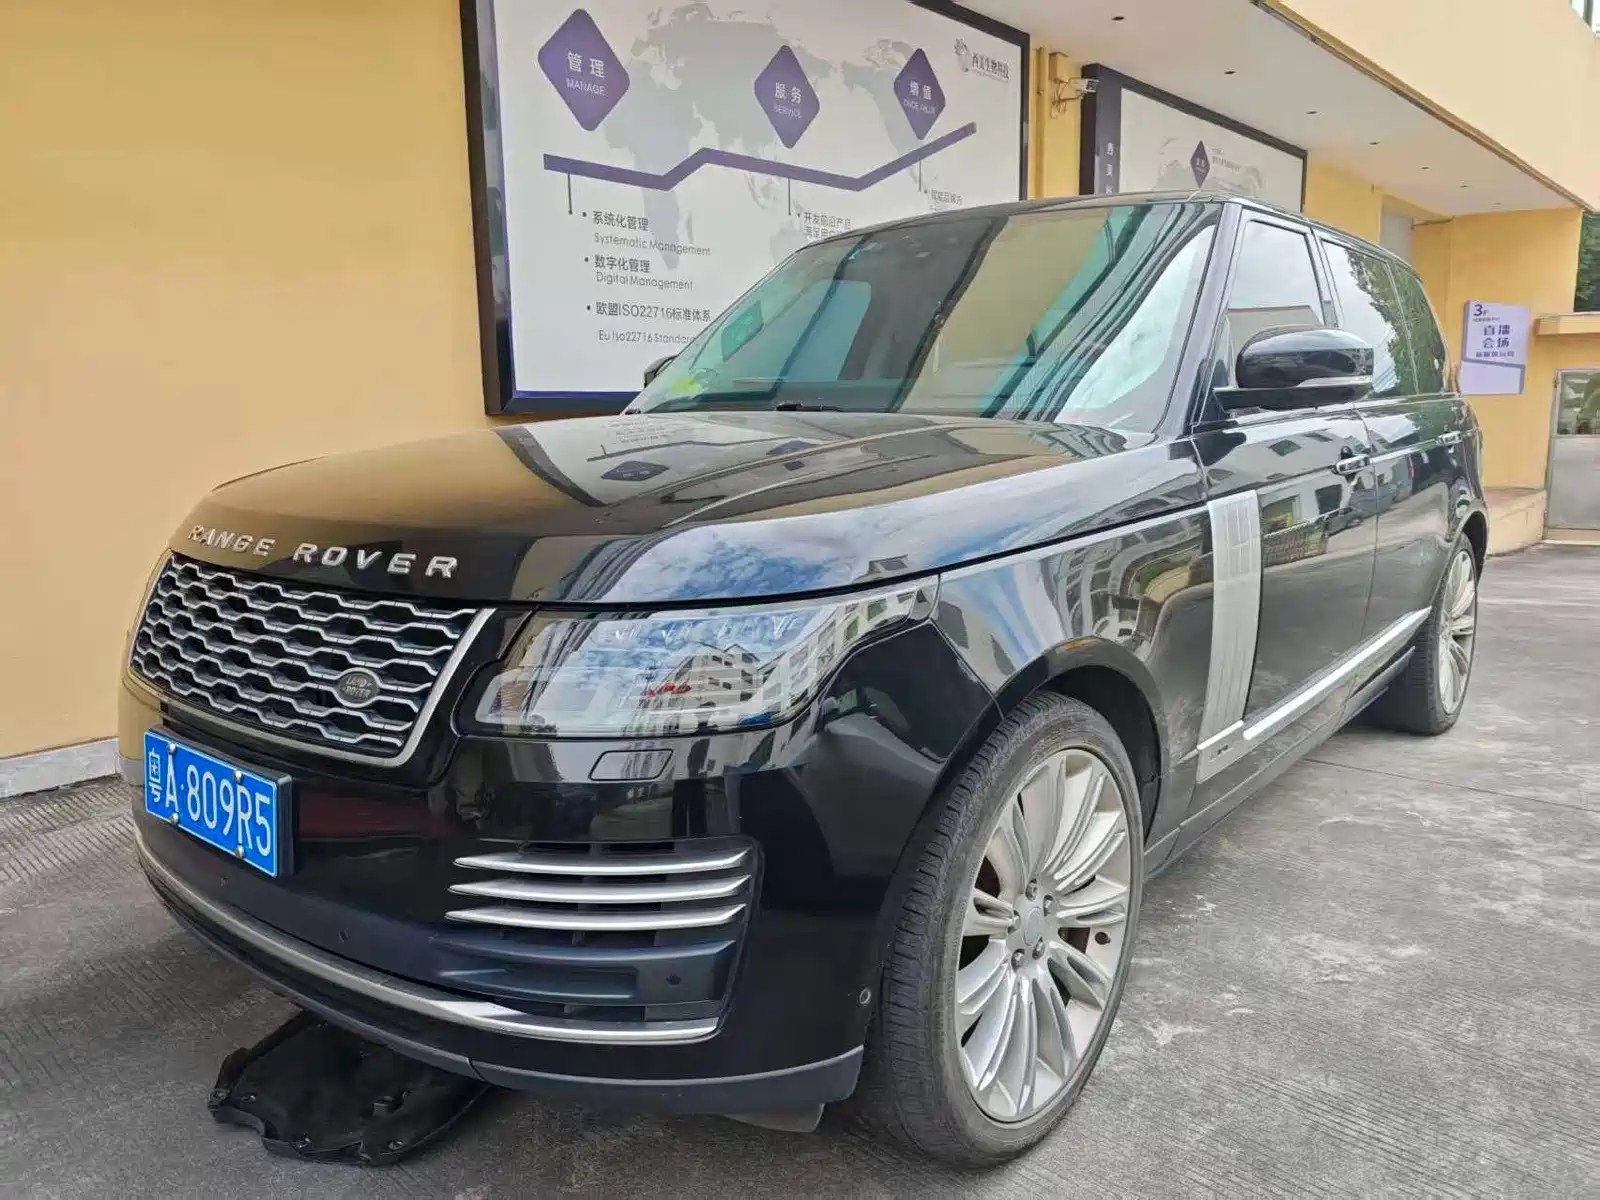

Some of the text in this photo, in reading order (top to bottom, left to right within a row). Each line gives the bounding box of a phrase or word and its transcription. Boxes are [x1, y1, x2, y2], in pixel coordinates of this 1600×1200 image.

[567, 51, 605, 79] 管理
[566, 78, 606, 96] MANAGE
[775, 82, 802, 104] 服务
[910, 80, 932, 100] 增值
[593, 210, 649, 231] 系统化管理
[594, 232, 712, 256] Systematic Management
[594, 254, 650, 273] 数字化管理
[596, 271, 694, 291] Digital Management
[595, 301, 712, 322] 欧盟ISO22716标准体系
[187, 524, 459, 579] RANGE ROVER
